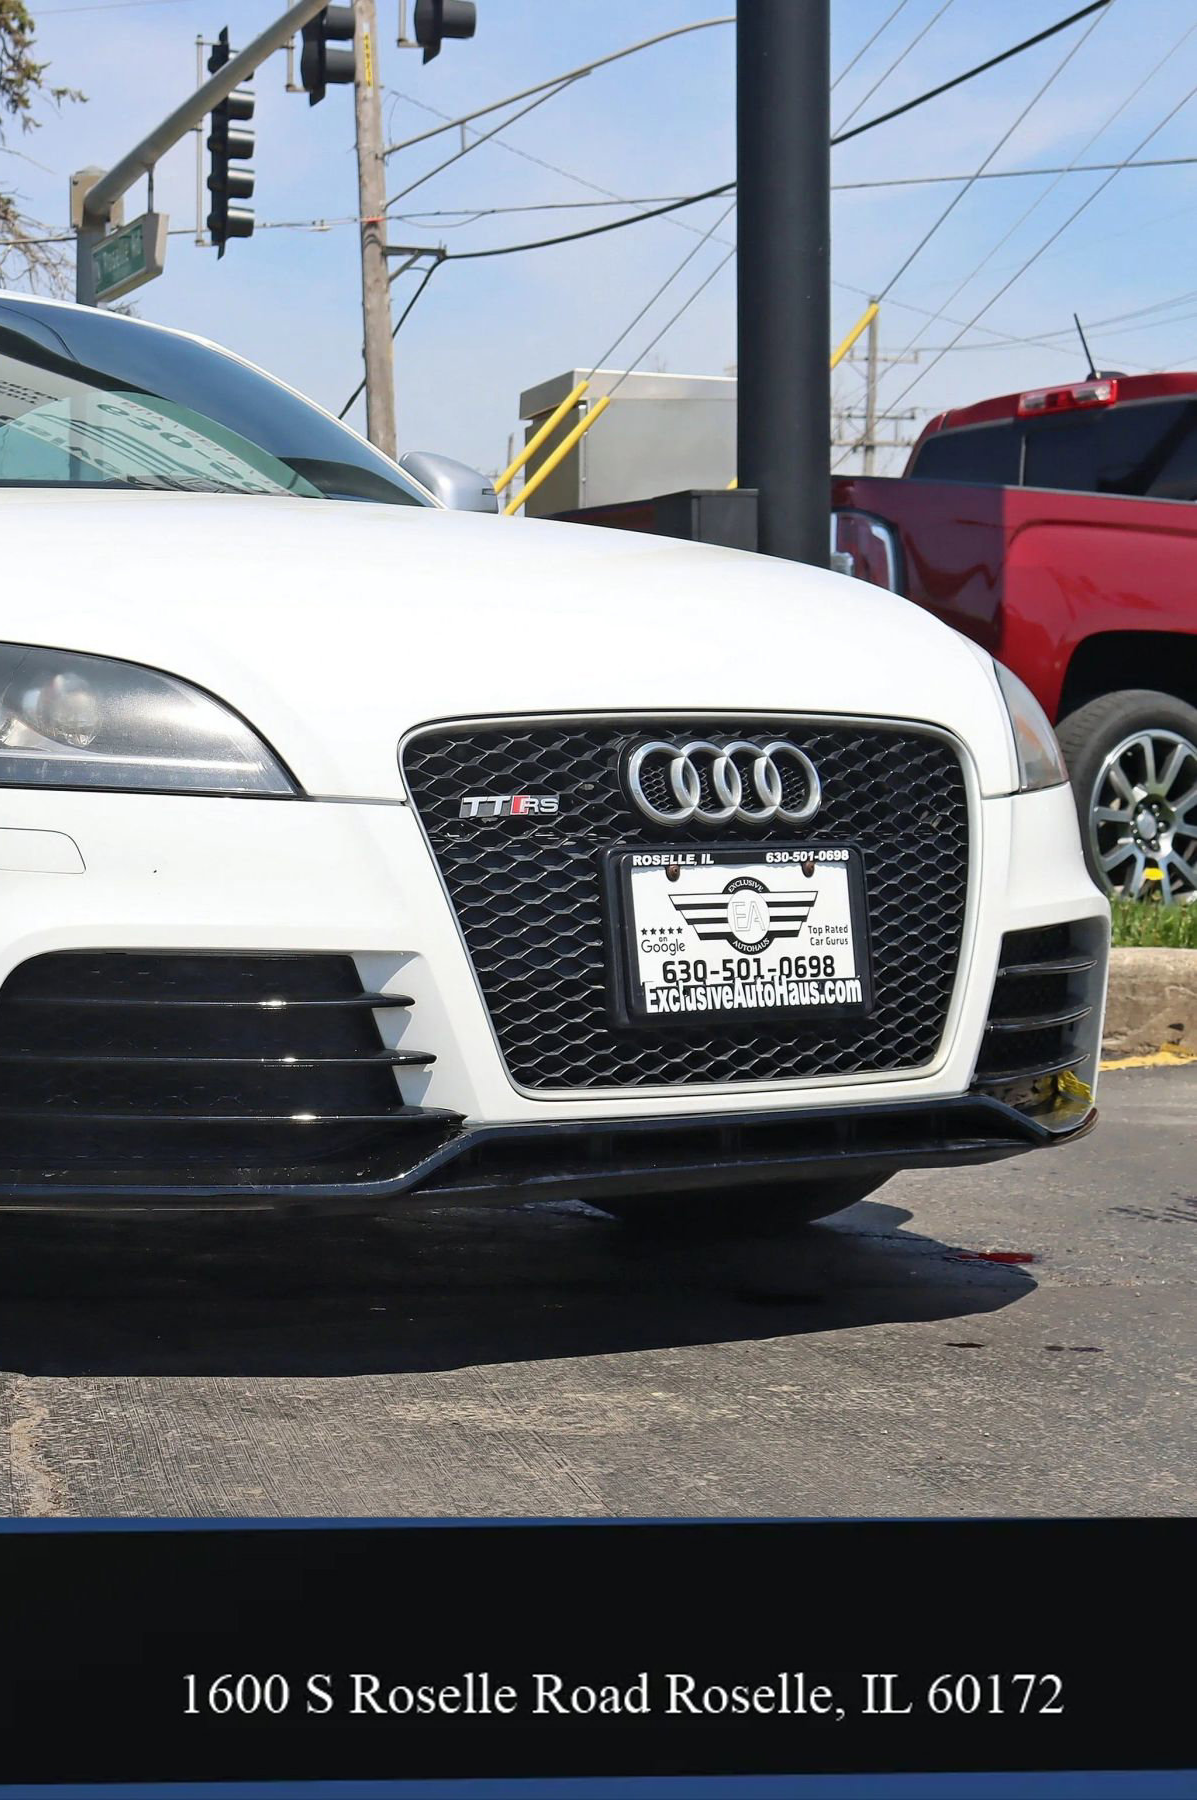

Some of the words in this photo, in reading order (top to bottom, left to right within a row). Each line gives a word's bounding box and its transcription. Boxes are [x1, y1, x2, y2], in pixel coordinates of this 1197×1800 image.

[632, 854, 698, 866] ROSELLE,
[701, 853, 715, 865] IL
[765, 850, 850, 863] 630-501-0698
[727, 878, 765, 893] EXCLUSIVE
[731, 900, 766, 933] EA
[808, 925, 823, 936] Top
[824, 924, 849, 935] Rated
[641, 939, 686, 956] Google
[732, 937, 770, 952] AUTOHAUS
[809, 937, 823, 947] Car
[825, 936, 849, 946] Gurus
[662, 955, 836, 984] 630-501-0698
[643, 975, 863, 1014] ExclusiveAutoHaus.com
